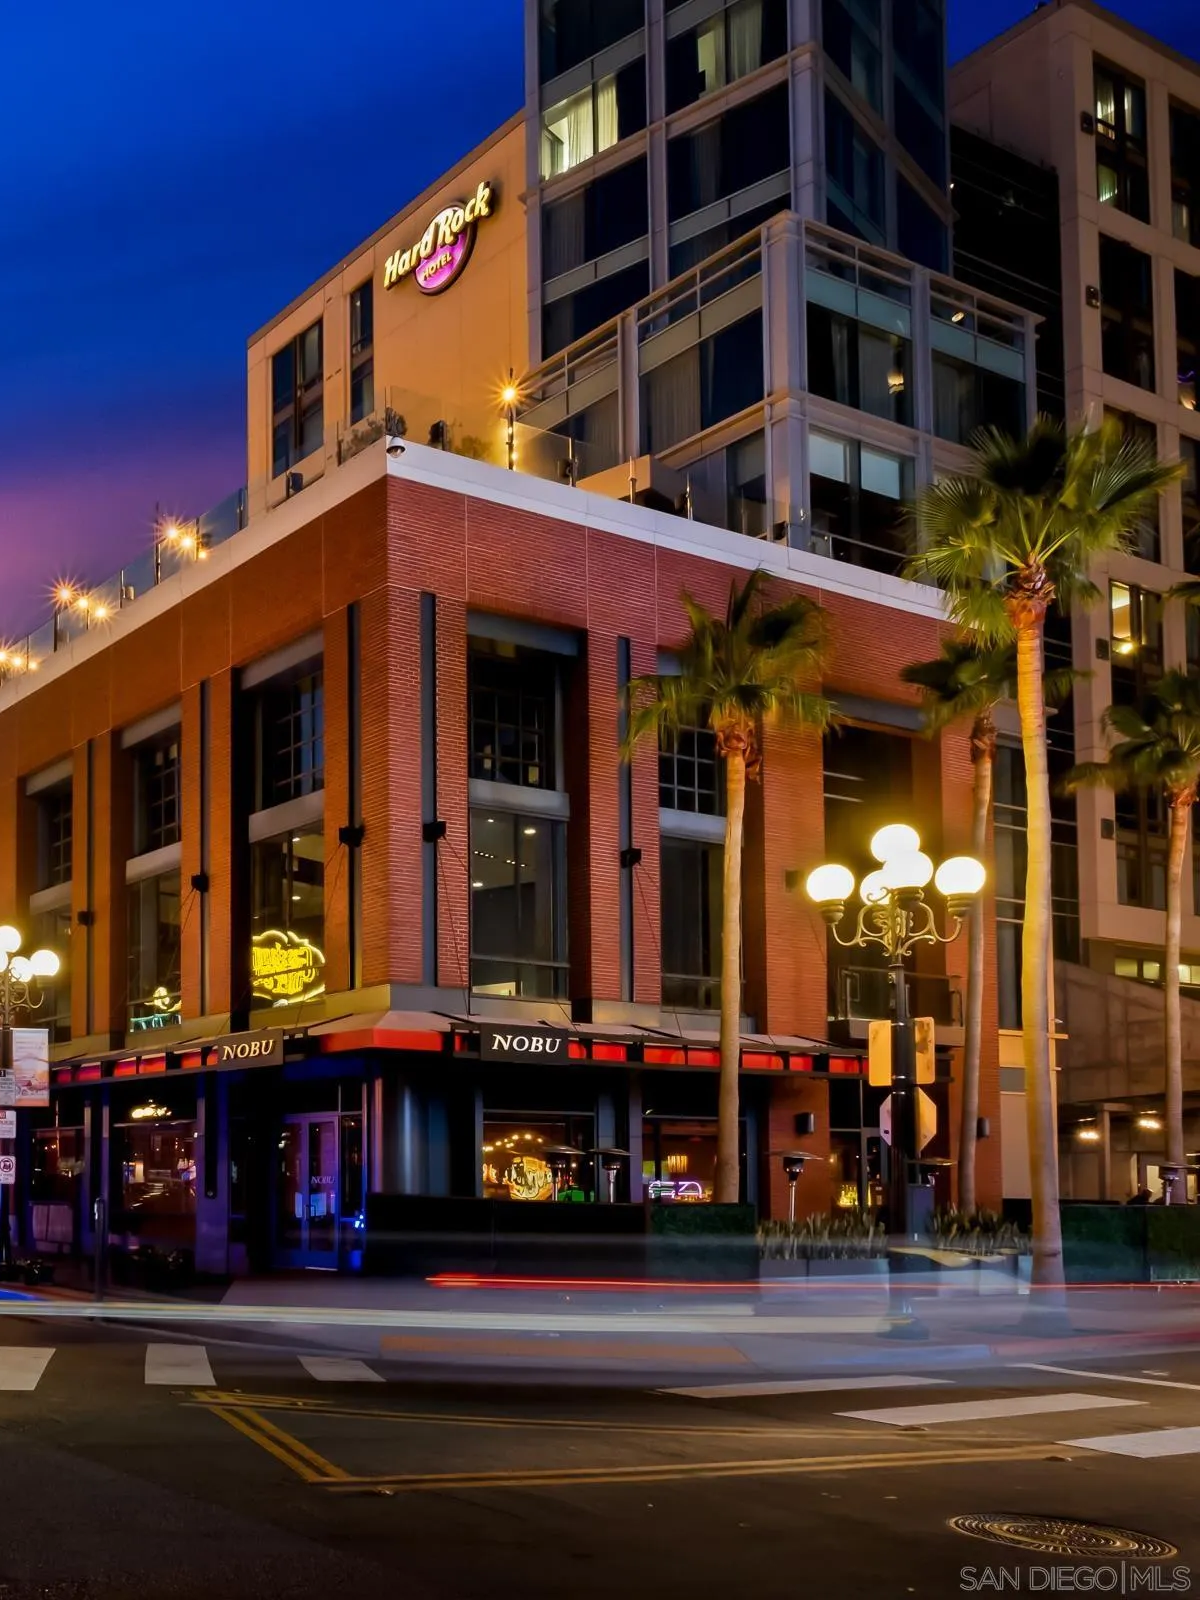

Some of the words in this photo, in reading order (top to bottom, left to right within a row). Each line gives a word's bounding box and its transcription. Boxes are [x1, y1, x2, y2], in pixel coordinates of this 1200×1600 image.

[383, 221, 437, 290] Hard
[437, 181, 491, 247] Rock
[423, 252, 452, 281] HOTEL
[222, 1039, 275, 1061] NOBU
[491, 1033, 562, 1053] NOBU
